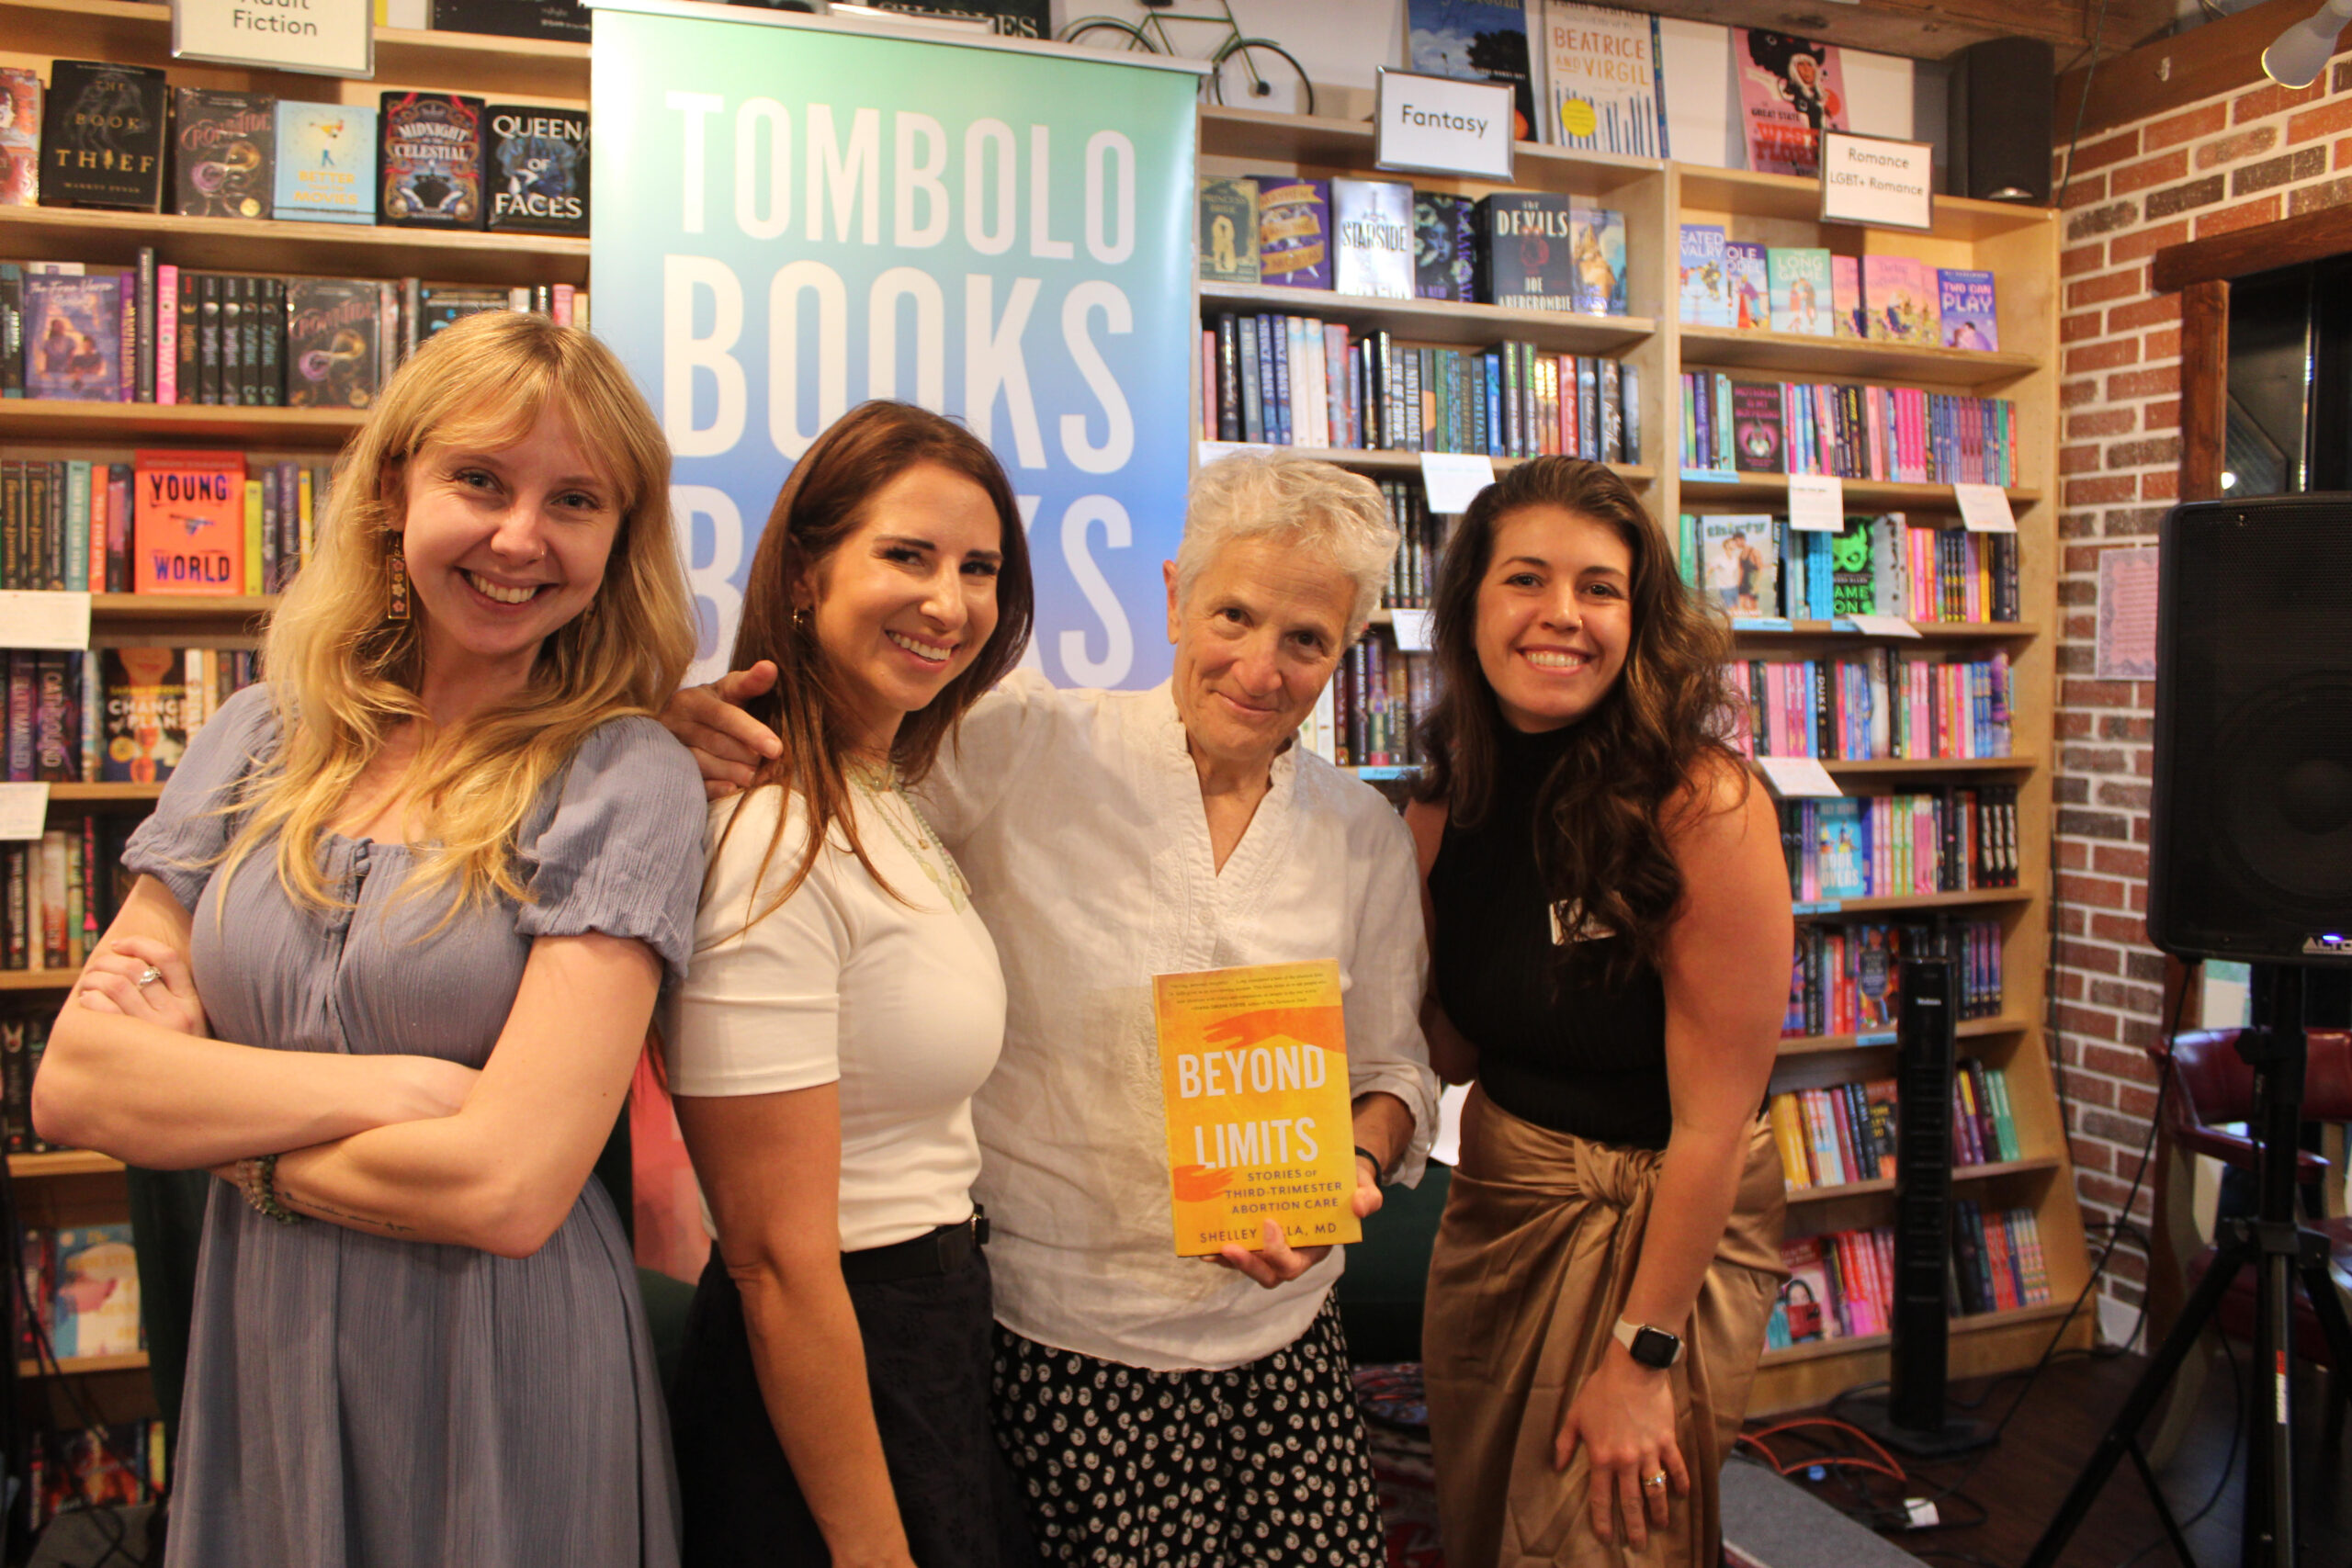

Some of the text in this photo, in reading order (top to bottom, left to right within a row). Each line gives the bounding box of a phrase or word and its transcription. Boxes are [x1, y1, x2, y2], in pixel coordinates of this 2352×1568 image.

[233, 9, 318, 36] Fiction
[1553, 26, 1645, 60] BEATRICE
[1585, 56, 1650, 86] VIRGIL
[75, 113, 141, 130] BOOK
[492, 115, 583, 141] QUEEN
[1401, 103, 1488, 140] Fantasy
[55, 148, 154, 174] THIEF
[527, 158, 551, 172] OF
[1848, 146, 1910, 170] Romance
[665, 89, 1136, 265] TOMBOLO
[1829, 171, 1924, 197] LGBT+ Romance
[494, 193, 583, 220] FACES
[1496, 209, 1568, 238] DEVILS
[1679, 231, 1724, 245] EATED
[1727, 246, 1758, 259] OLE
[1777, 255, 1824, 269] LONG
[1942, 292, 1993, 314] PLAY
[160, 286, 175, 386] HOLLOWAY
[662, 253, 1136, 475] BOOKS
[150, 473, 228, 502] YOUNG
[153, 554, 232, 583] WORLD
[1834, 585, 1870, 601] AME
[1833, 600, 1859, 615] ON
[1816, 674, 1826, 713] DUKE
[1178, 1043, 1327, 1099] BEYOND
[1195, 1117, 1319, 1169] LIMITS
[1248, 1168, 1317, 1182] STORIES OF
[1225, 1181, 1343, 1200] THIRD-TRIMESTER
[1232, 1198, 1339, 1214] ABORTION CARE
[1199, 1228, 1258, 1244] SHELLEY
[1315, 1223, 1338, 1235] MD
